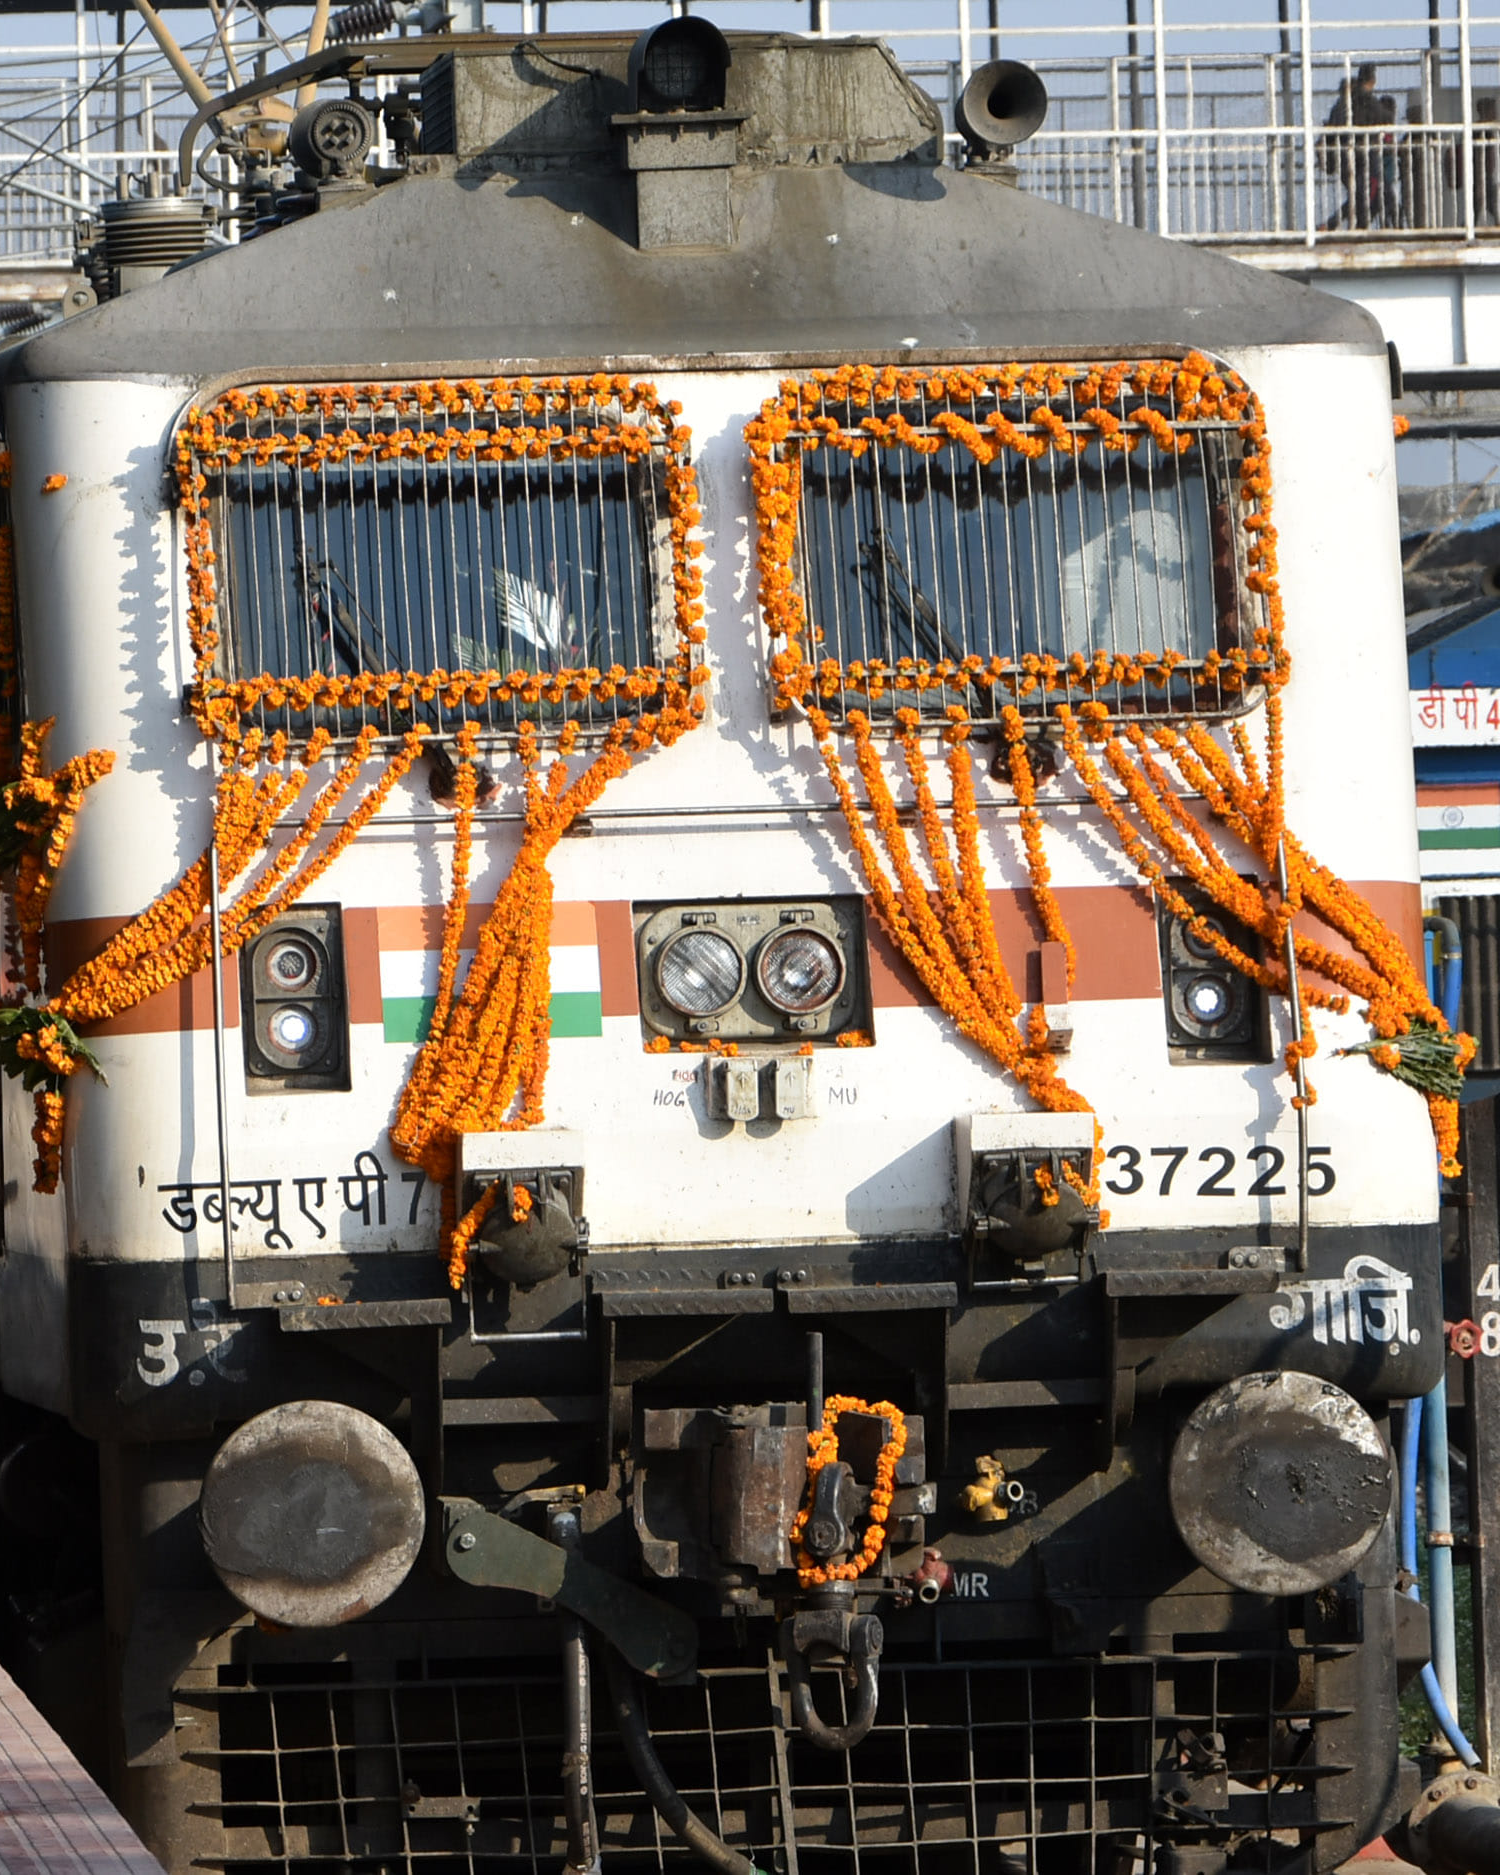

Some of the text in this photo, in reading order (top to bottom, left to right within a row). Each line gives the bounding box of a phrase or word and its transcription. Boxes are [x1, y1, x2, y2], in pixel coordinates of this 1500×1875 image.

[1417, 682, 1446, 730] डी
[1453, 680, 1479, 730] पी
[652, 1088, 686, 1108] HOG
[828, 1086, 858, 1105] MU
[1105, 1144, 1337, 1197] 37225
[292, 1176, 328, 1240] ए
[337, 1150, 389, 1227] पी
[400, 1171, 427, 1226] 7
[1476, 1263, 1500, 1302] 4
[1480, 1311, 1500, 1358] 8
